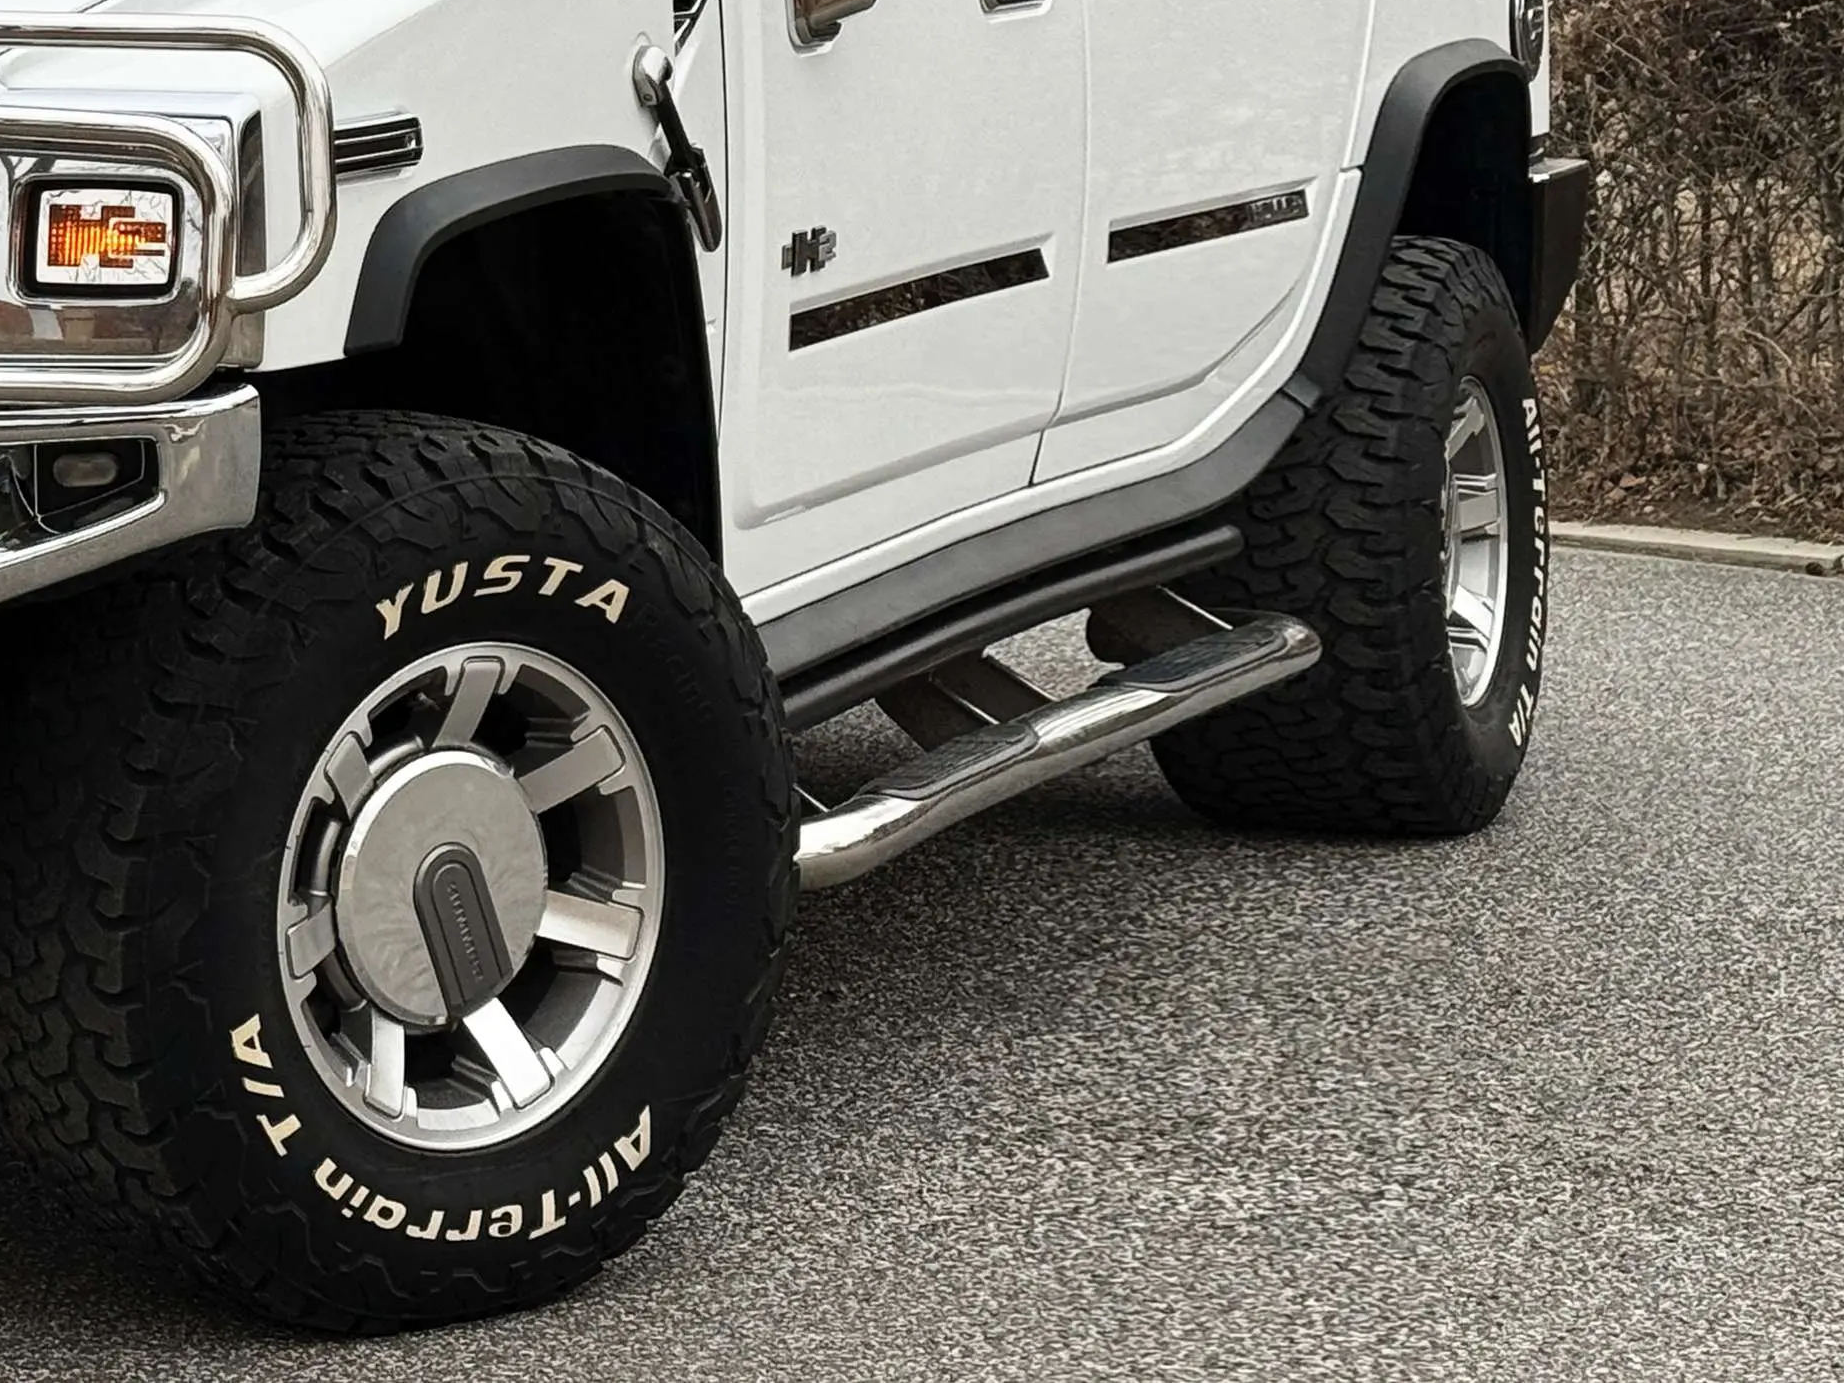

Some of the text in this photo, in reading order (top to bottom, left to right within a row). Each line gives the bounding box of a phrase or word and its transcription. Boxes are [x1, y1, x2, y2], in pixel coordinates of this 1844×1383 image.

[375, 554, 630, 640] YUSTA
[1508, 397, 1547, 747] All-Terrain T/A
[229, 1013, 651, 1242] All-Terrain T/A
